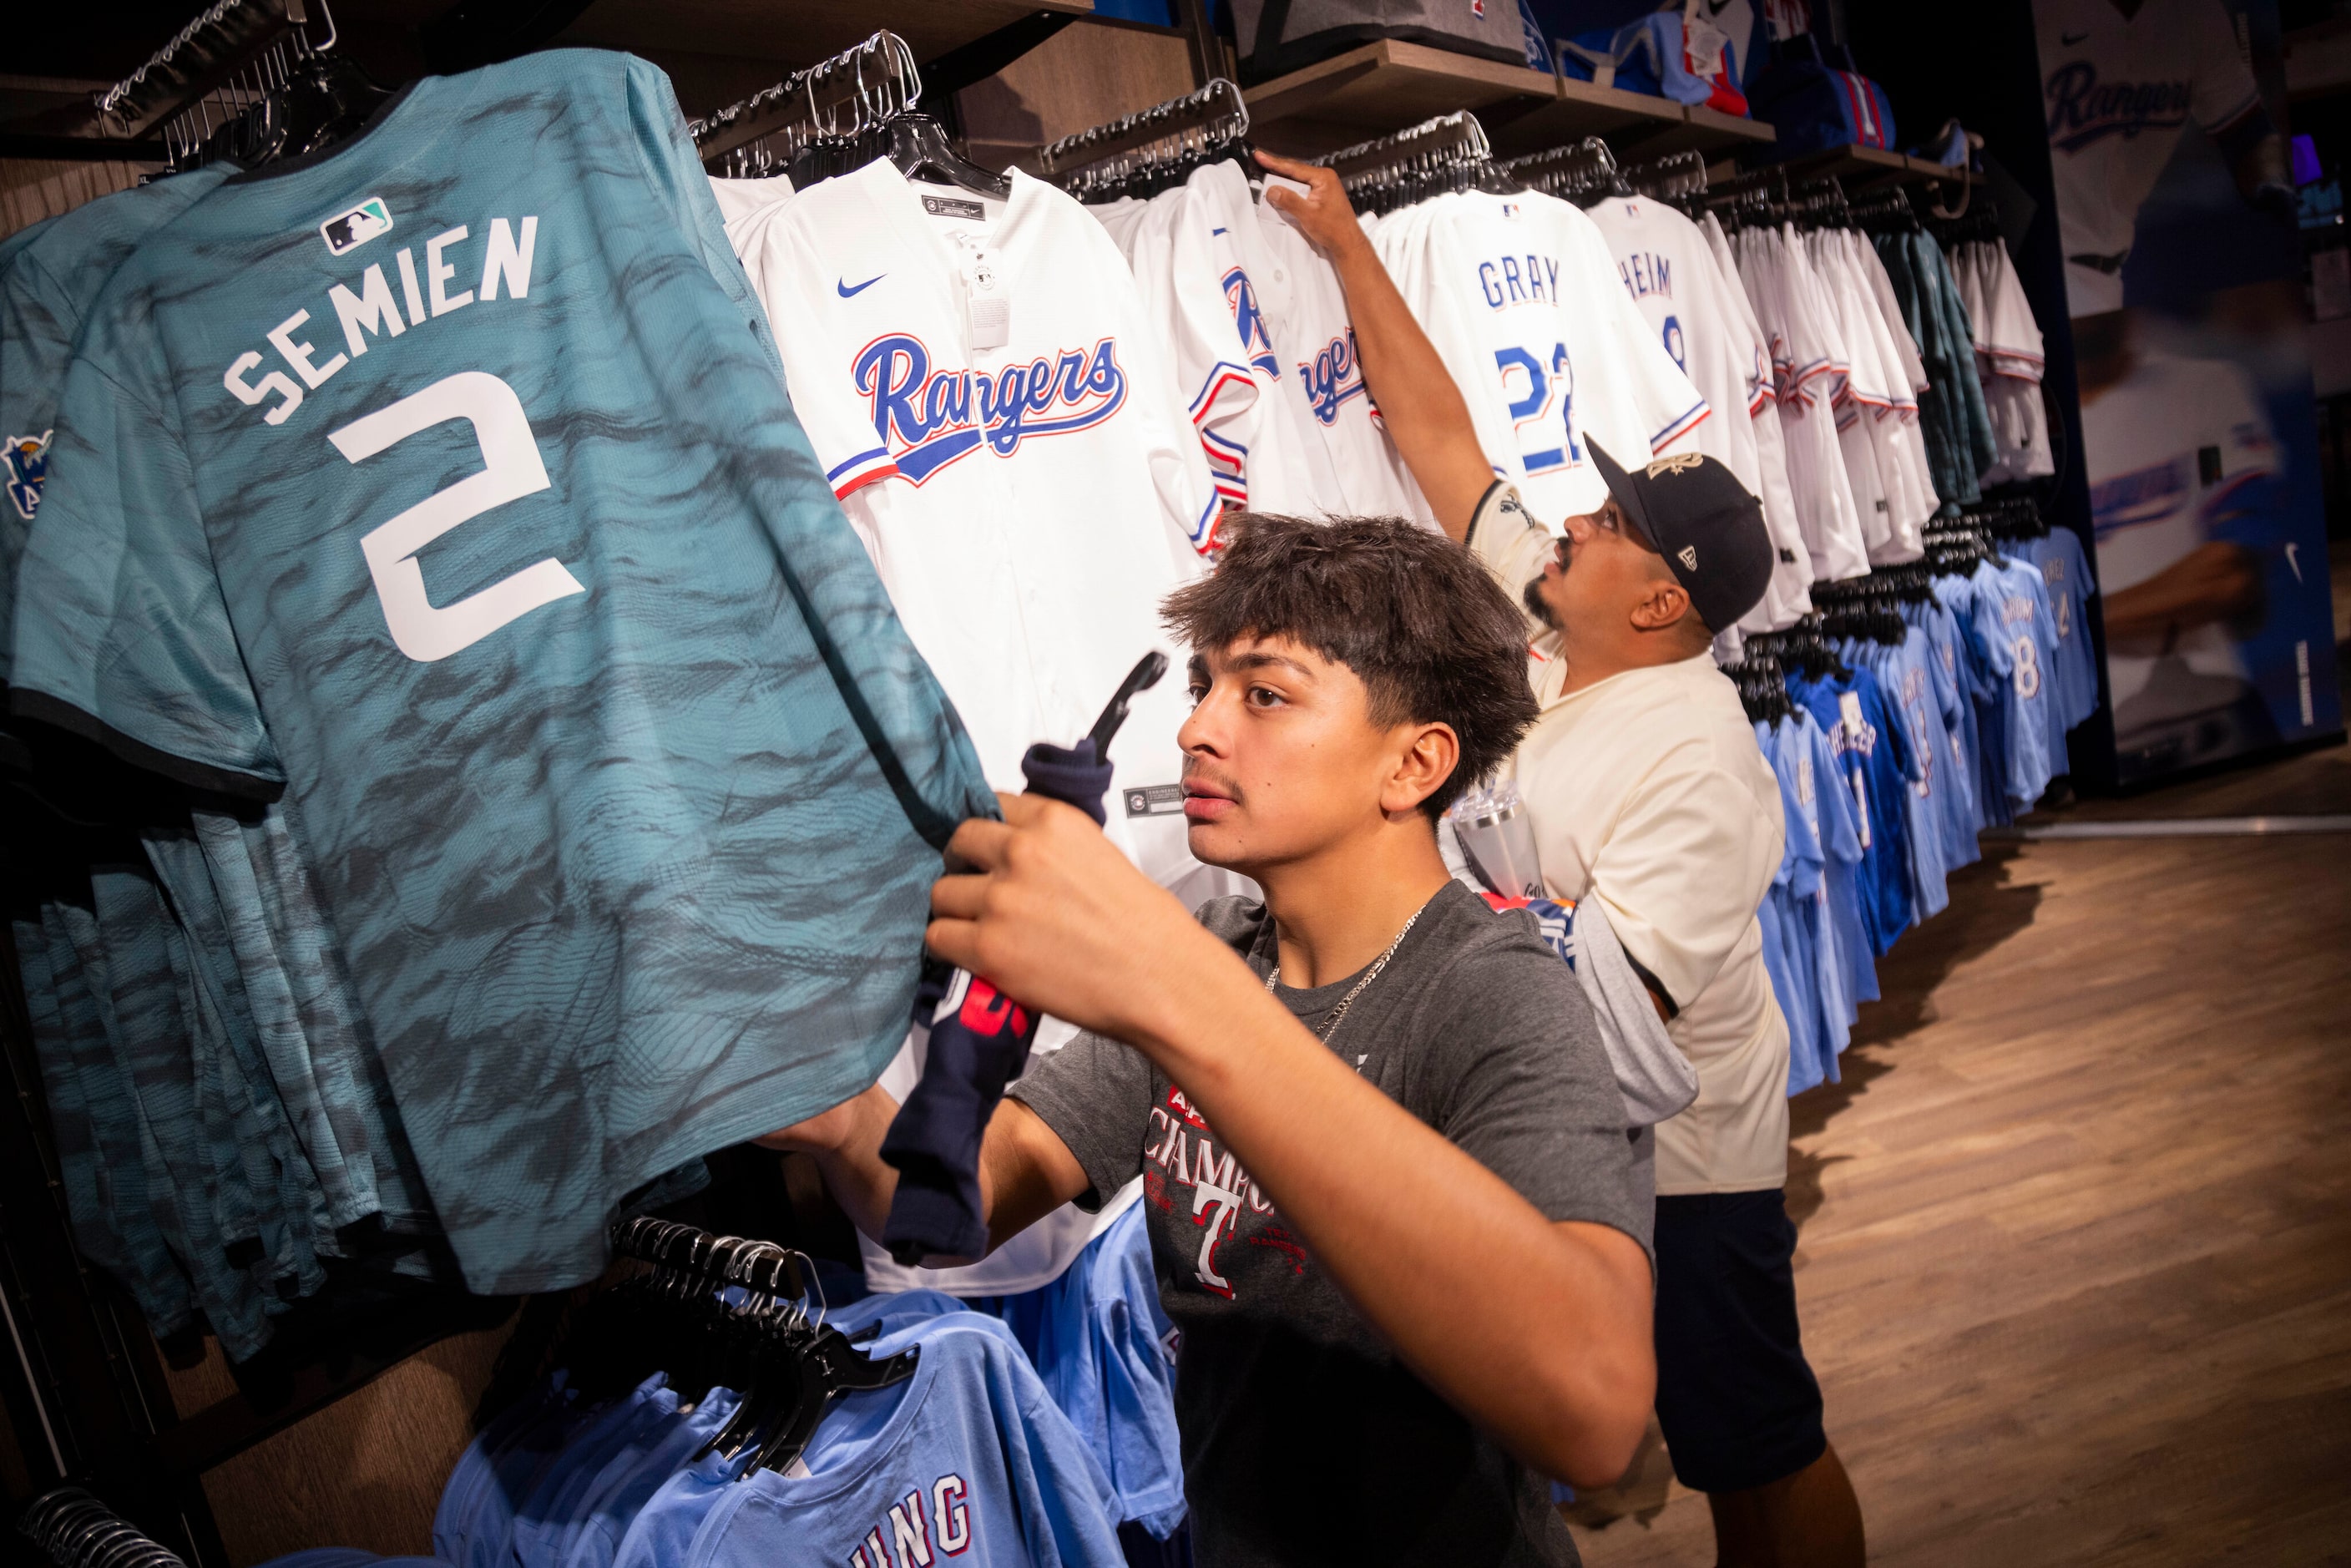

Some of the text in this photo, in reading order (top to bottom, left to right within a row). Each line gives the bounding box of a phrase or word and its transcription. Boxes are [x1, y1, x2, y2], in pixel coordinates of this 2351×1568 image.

[224, 216, 538, 426] SEMIEN
[1478, 254, 1560, 312] GRAY
[851, 332, 1127, 480] Rangers
[327, 371, 586, 663] 2
[1191, 1180, 1243, 1300] T
